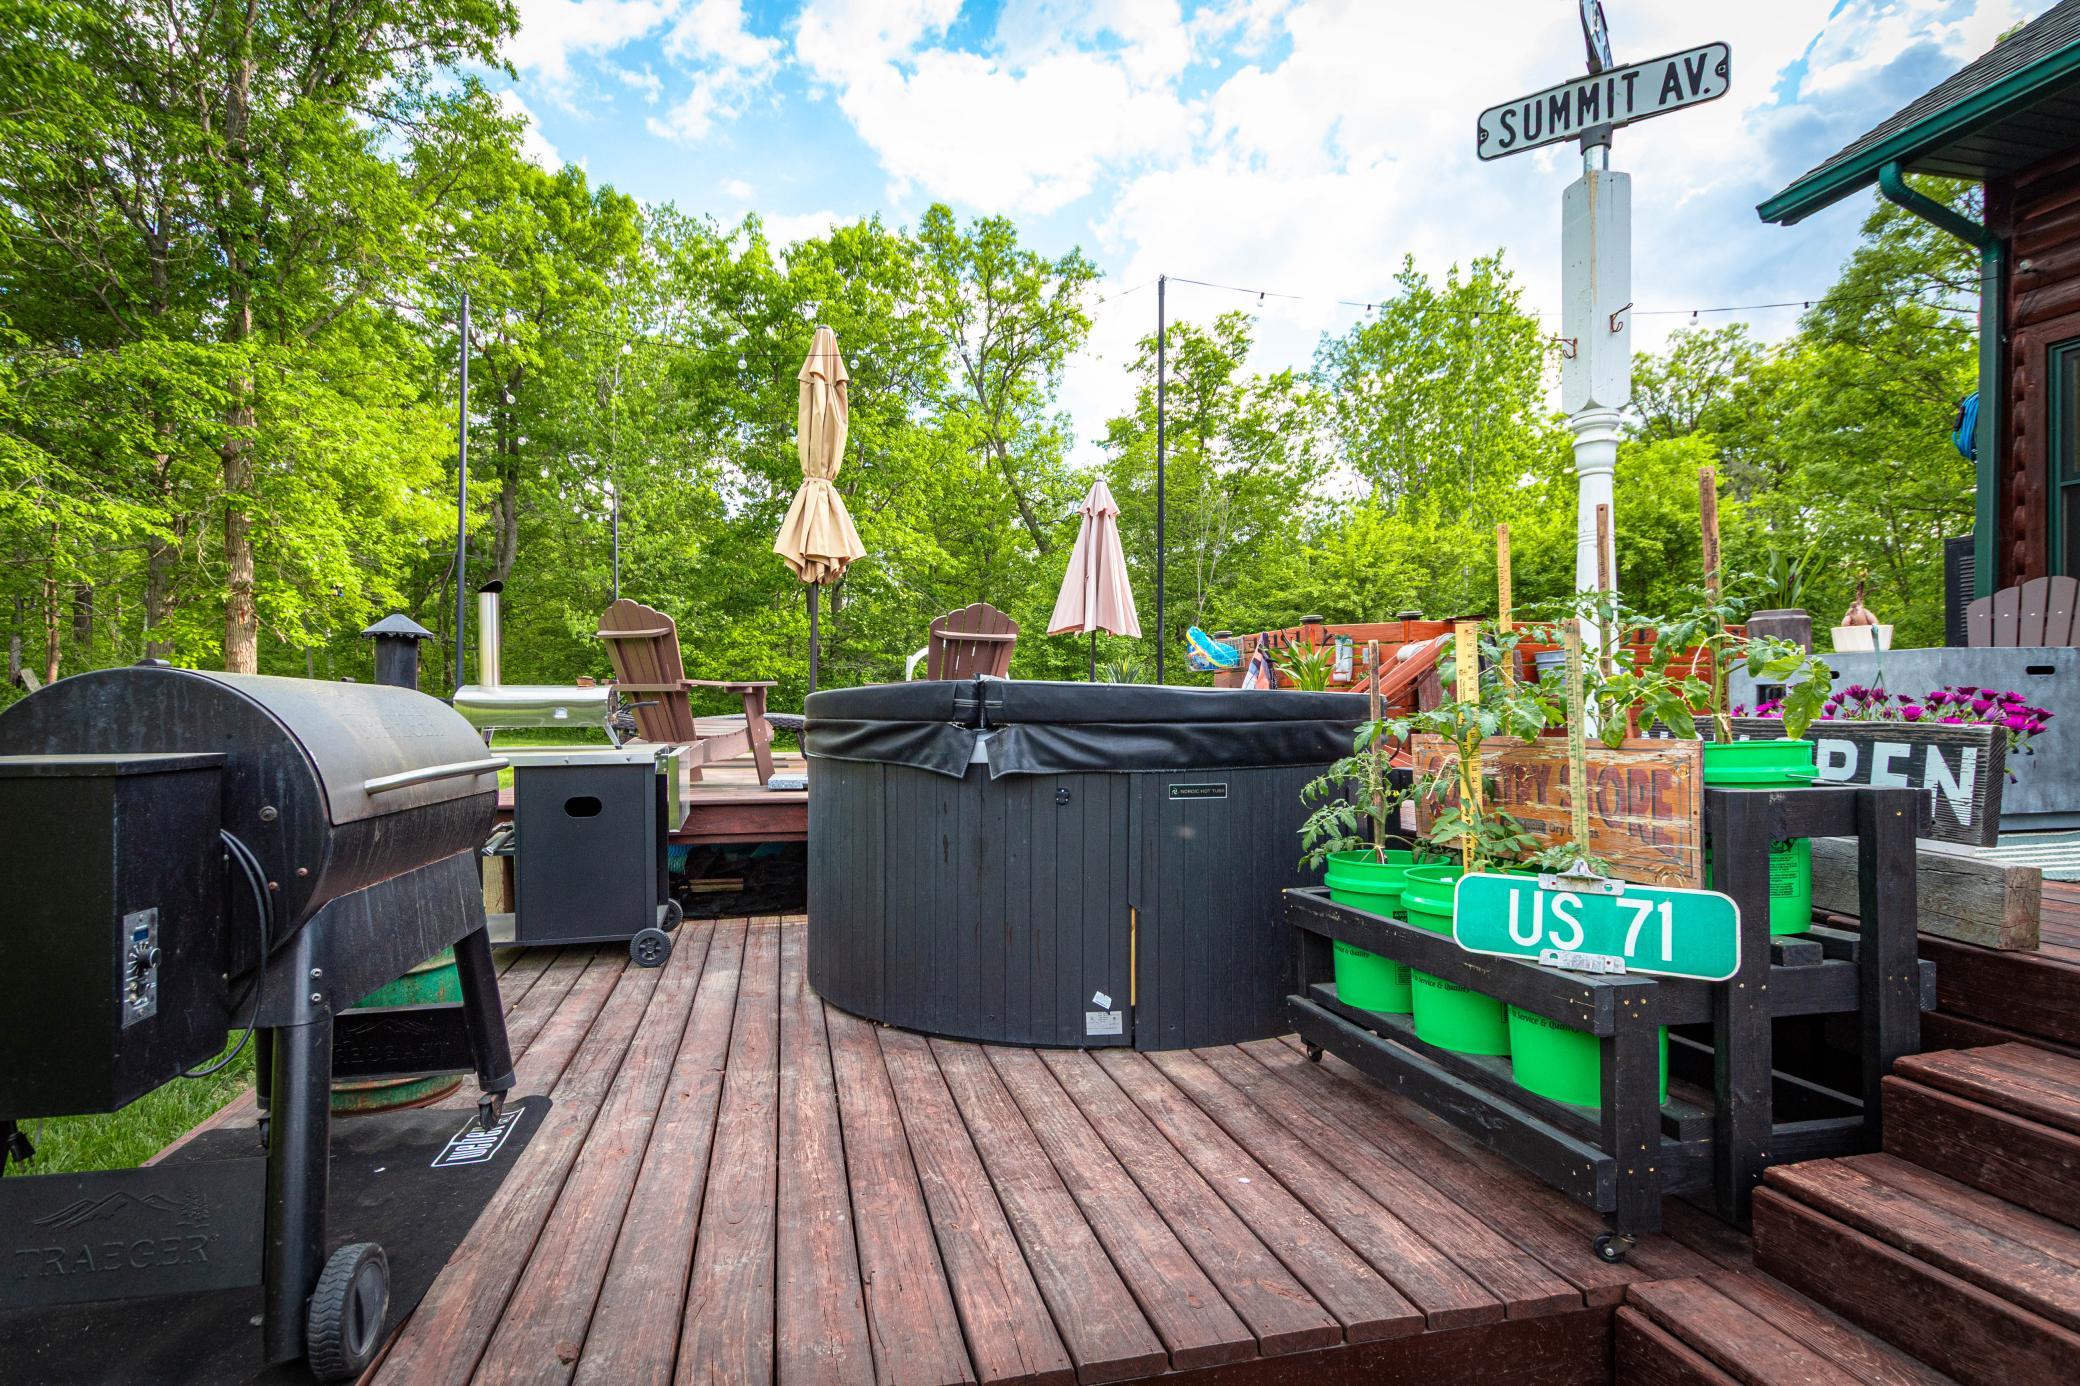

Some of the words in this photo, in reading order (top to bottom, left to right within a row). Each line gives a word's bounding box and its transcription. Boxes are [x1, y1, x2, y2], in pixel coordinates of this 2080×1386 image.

[1499, 71, 1640, 148] SUMMIT
[1658, 52, 1711, 105] AV.
[1776, 736, 1978, 826] PEN
[1549, 823, 1565, 837] Dry
[1508, 888, 1585, 951] US
[1615, 897, 1673, 962] 71
[15, 1235, 209, 1277] TRAEGER
